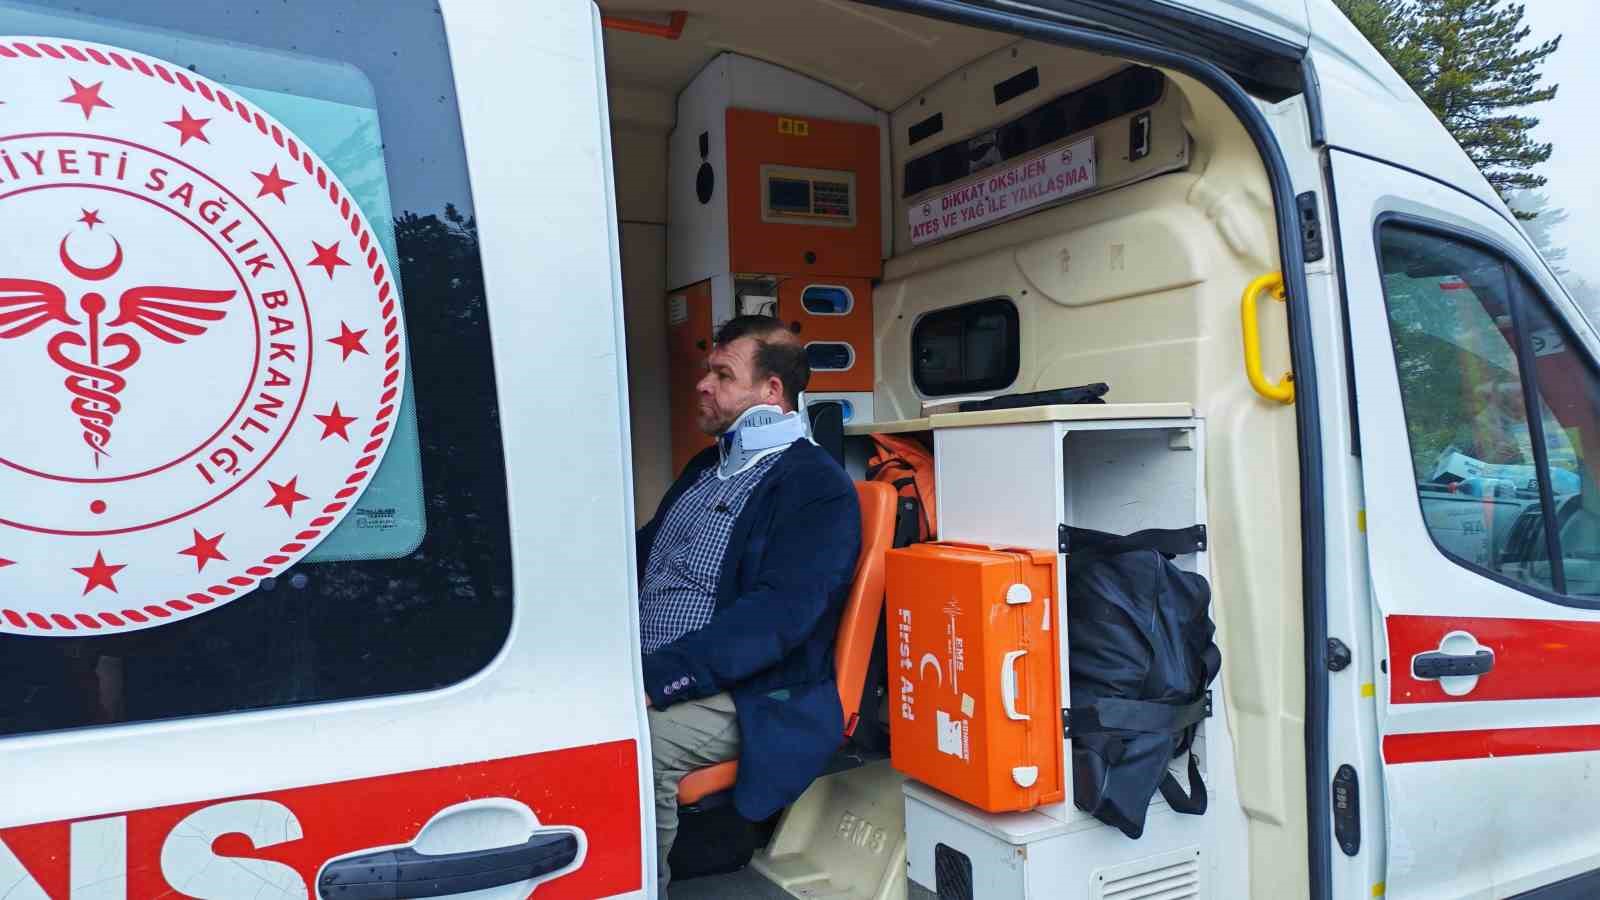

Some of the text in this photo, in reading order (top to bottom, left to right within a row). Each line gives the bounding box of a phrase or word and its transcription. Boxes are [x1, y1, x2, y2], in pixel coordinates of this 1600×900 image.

[911, 217, 941, 240] ATEŞ
[941, 211, 958, 229] VE
[1010, 164, 1090, 202] YAKLAŞMA
[0, 149, 296, 484] İYETİ SAĞLIK BAKANLIĞI
[898, 608, 916, 721] First Aid
